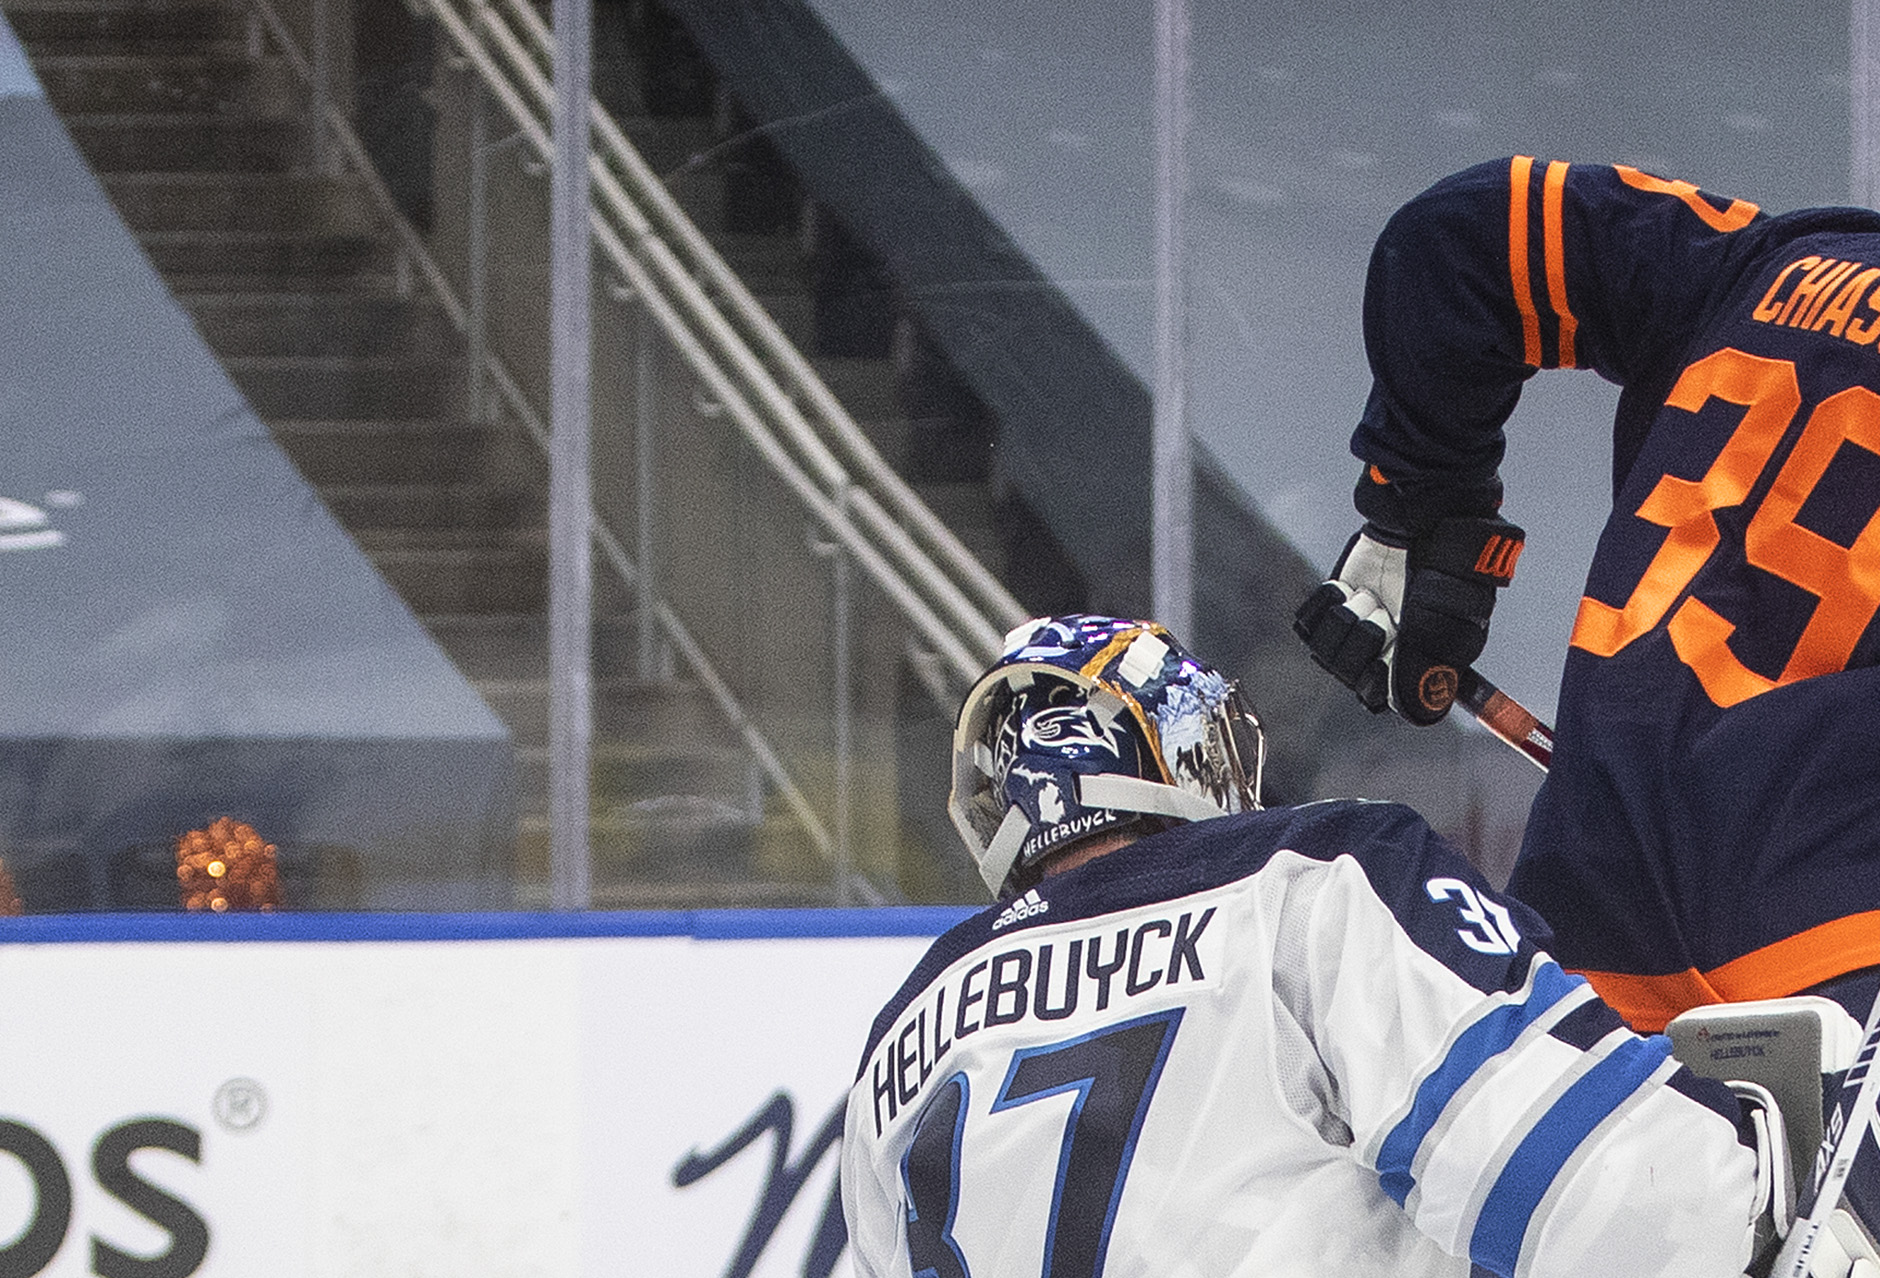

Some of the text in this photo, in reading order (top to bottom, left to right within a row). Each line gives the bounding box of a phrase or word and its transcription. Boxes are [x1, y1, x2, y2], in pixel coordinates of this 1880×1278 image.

[1022, 808, 1117, 858] HELLEBUYCK
[992, 900, 1049, 930] adidas
[872, 904, 1220, 1138] HELLEBUYCK
